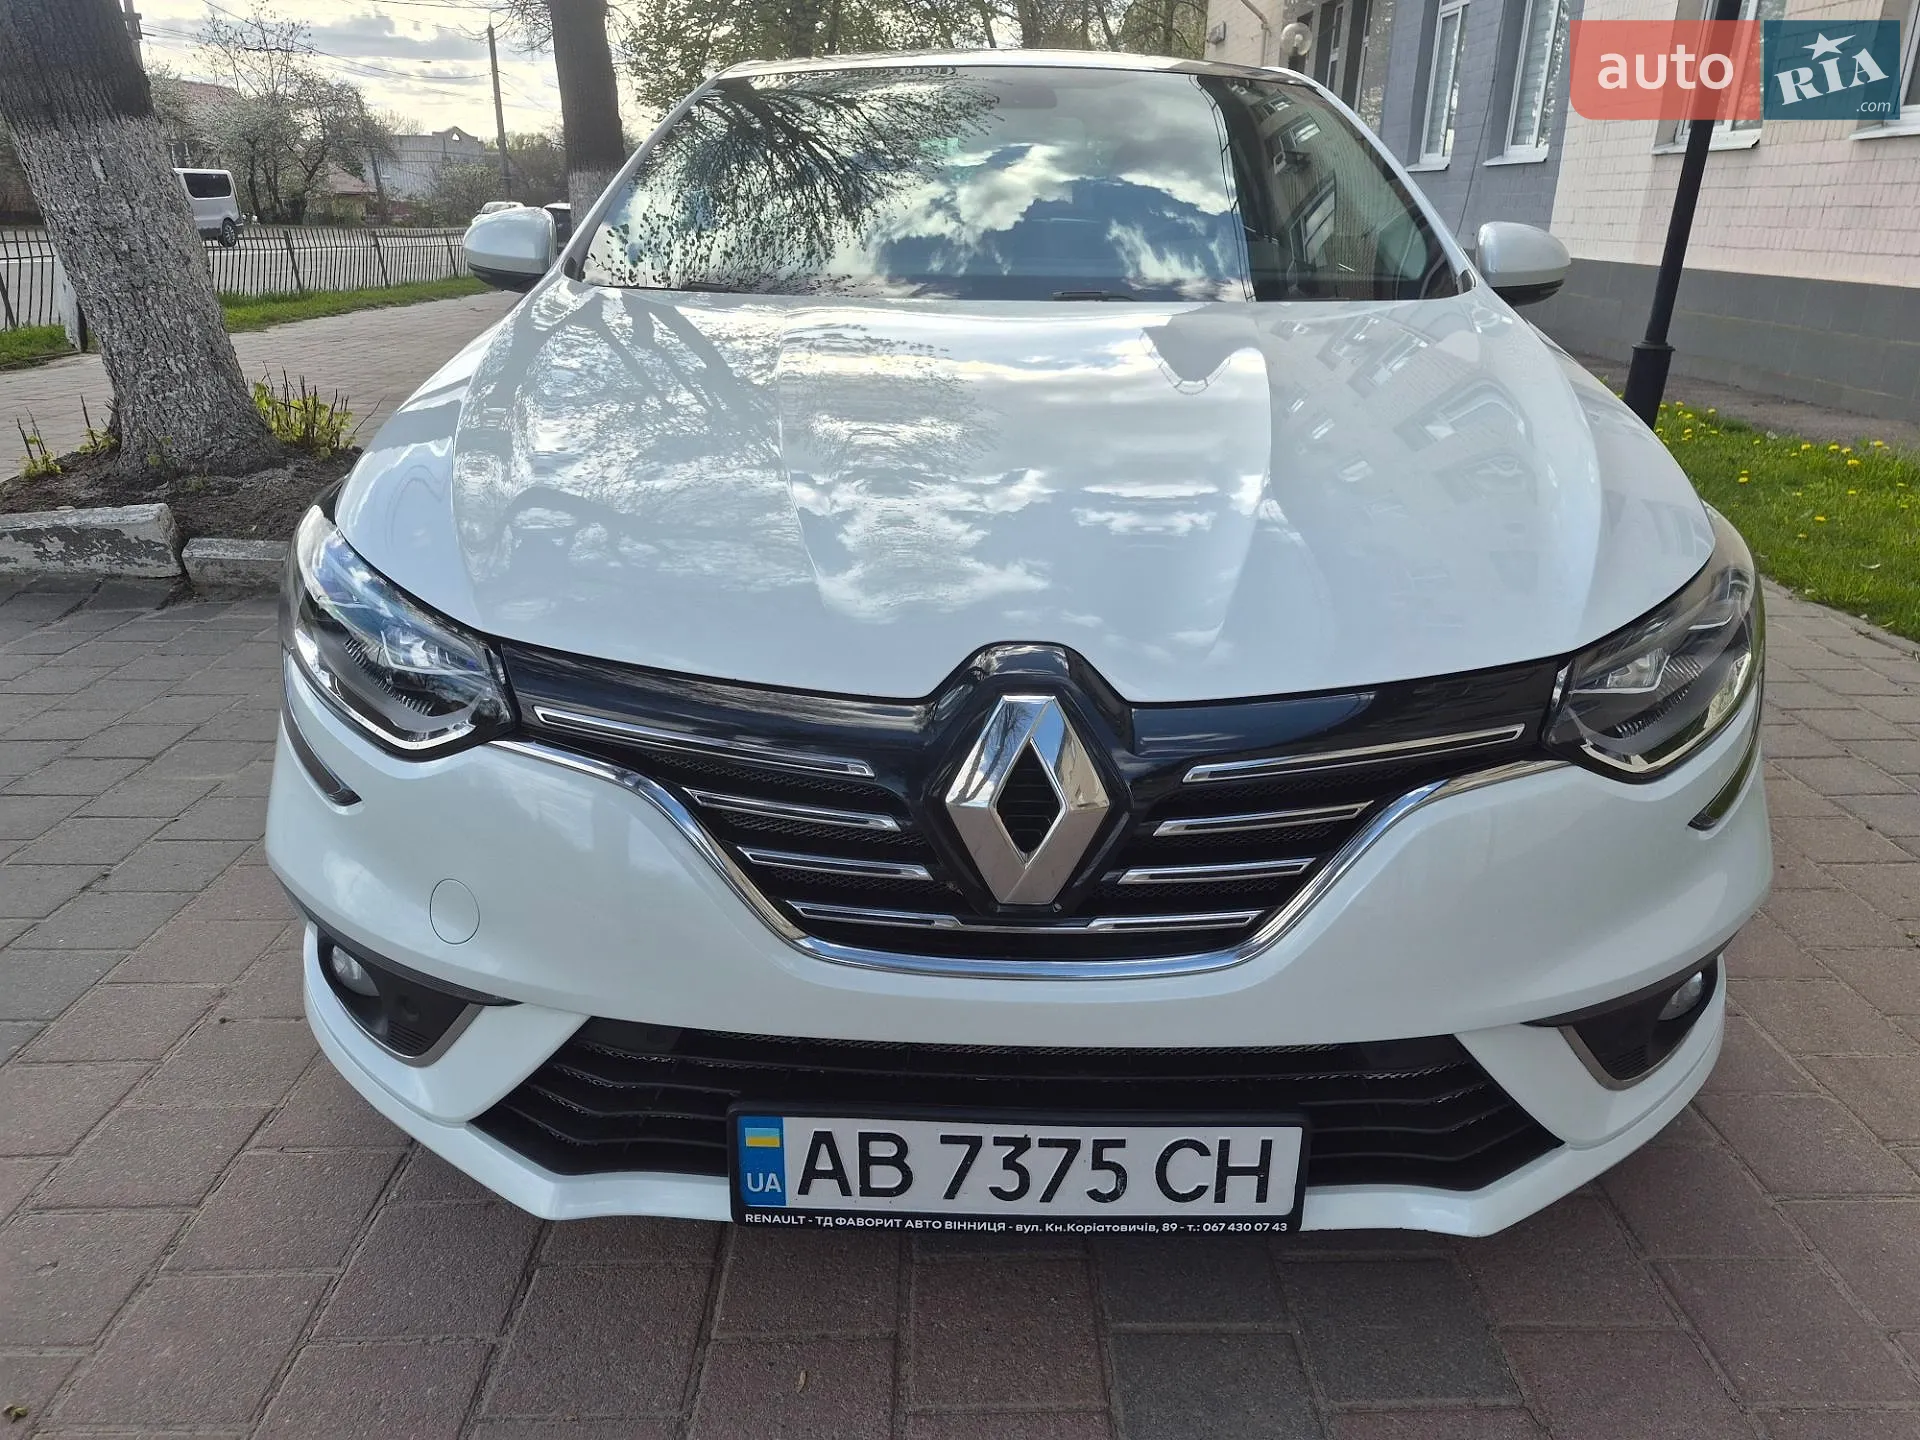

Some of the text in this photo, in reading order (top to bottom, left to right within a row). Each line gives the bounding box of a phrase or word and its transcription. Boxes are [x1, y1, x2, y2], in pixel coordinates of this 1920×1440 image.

[797, 1130, 1273, 1204] AB 7375 CH
[746, 1172, 783, 1194] UA
[745, 1213, 806, 1225] RENAULT
[815, 1216, 833, 1228] ТД
[835, 1216, 903, 1229] ФАВОРИТ
[905, 1218, 943, 1230] АВТО
[945, 1220, 1006, 1233] ВІННИЦЯ
[1015, 1224, 1042, 1234] вул.
[1162, 1223, 1178, 1232] 89
[1202, 1222, 1226, 1232] 067
[1254, 1222, 1270, 1232] 07
[1271, 1222, 1288, 1232] 43
